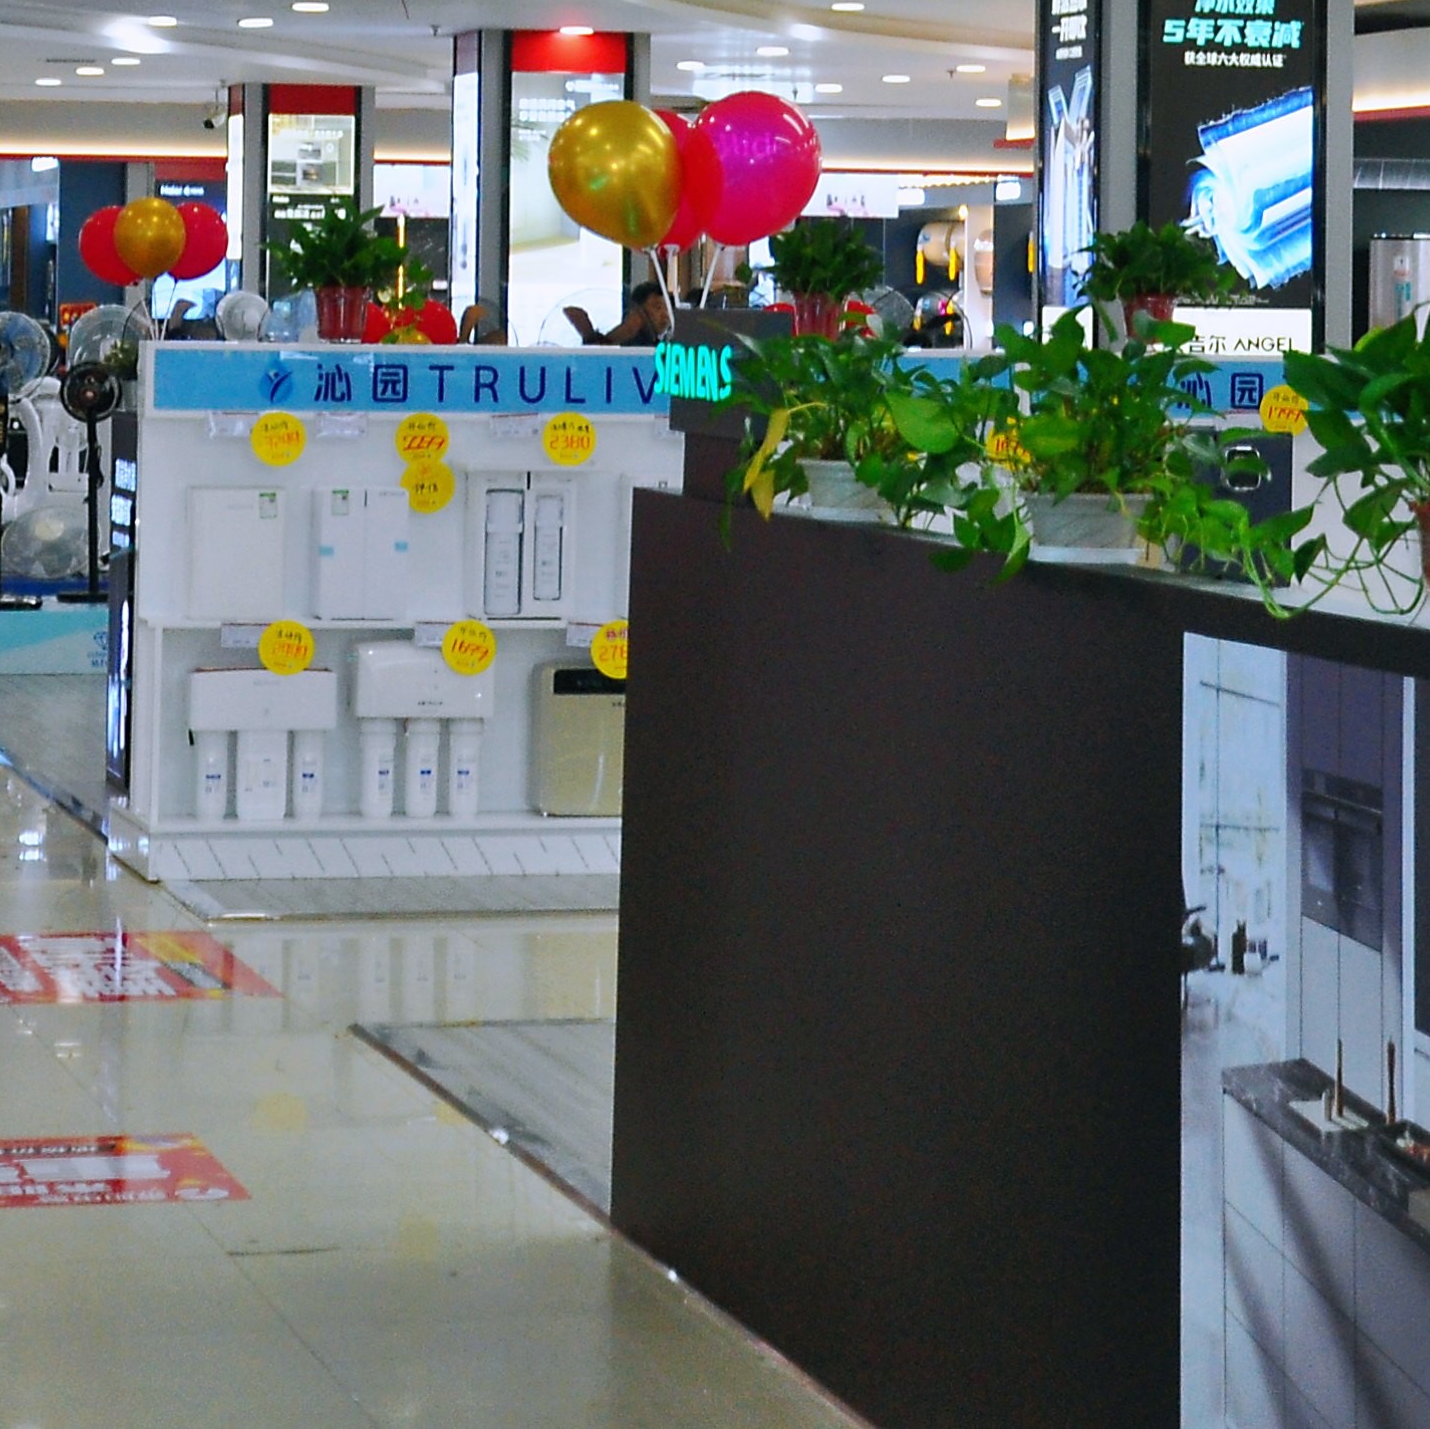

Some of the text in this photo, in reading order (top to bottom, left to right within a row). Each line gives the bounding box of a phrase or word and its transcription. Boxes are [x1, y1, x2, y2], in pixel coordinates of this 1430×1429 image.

[1162, 17, 1303, 49] 5年不衰减
[1233, 336, 1295, 352] ANGEL
[314, 363, 408, 404] 沁园
[654, 341, 732, 403] SIEMENS
